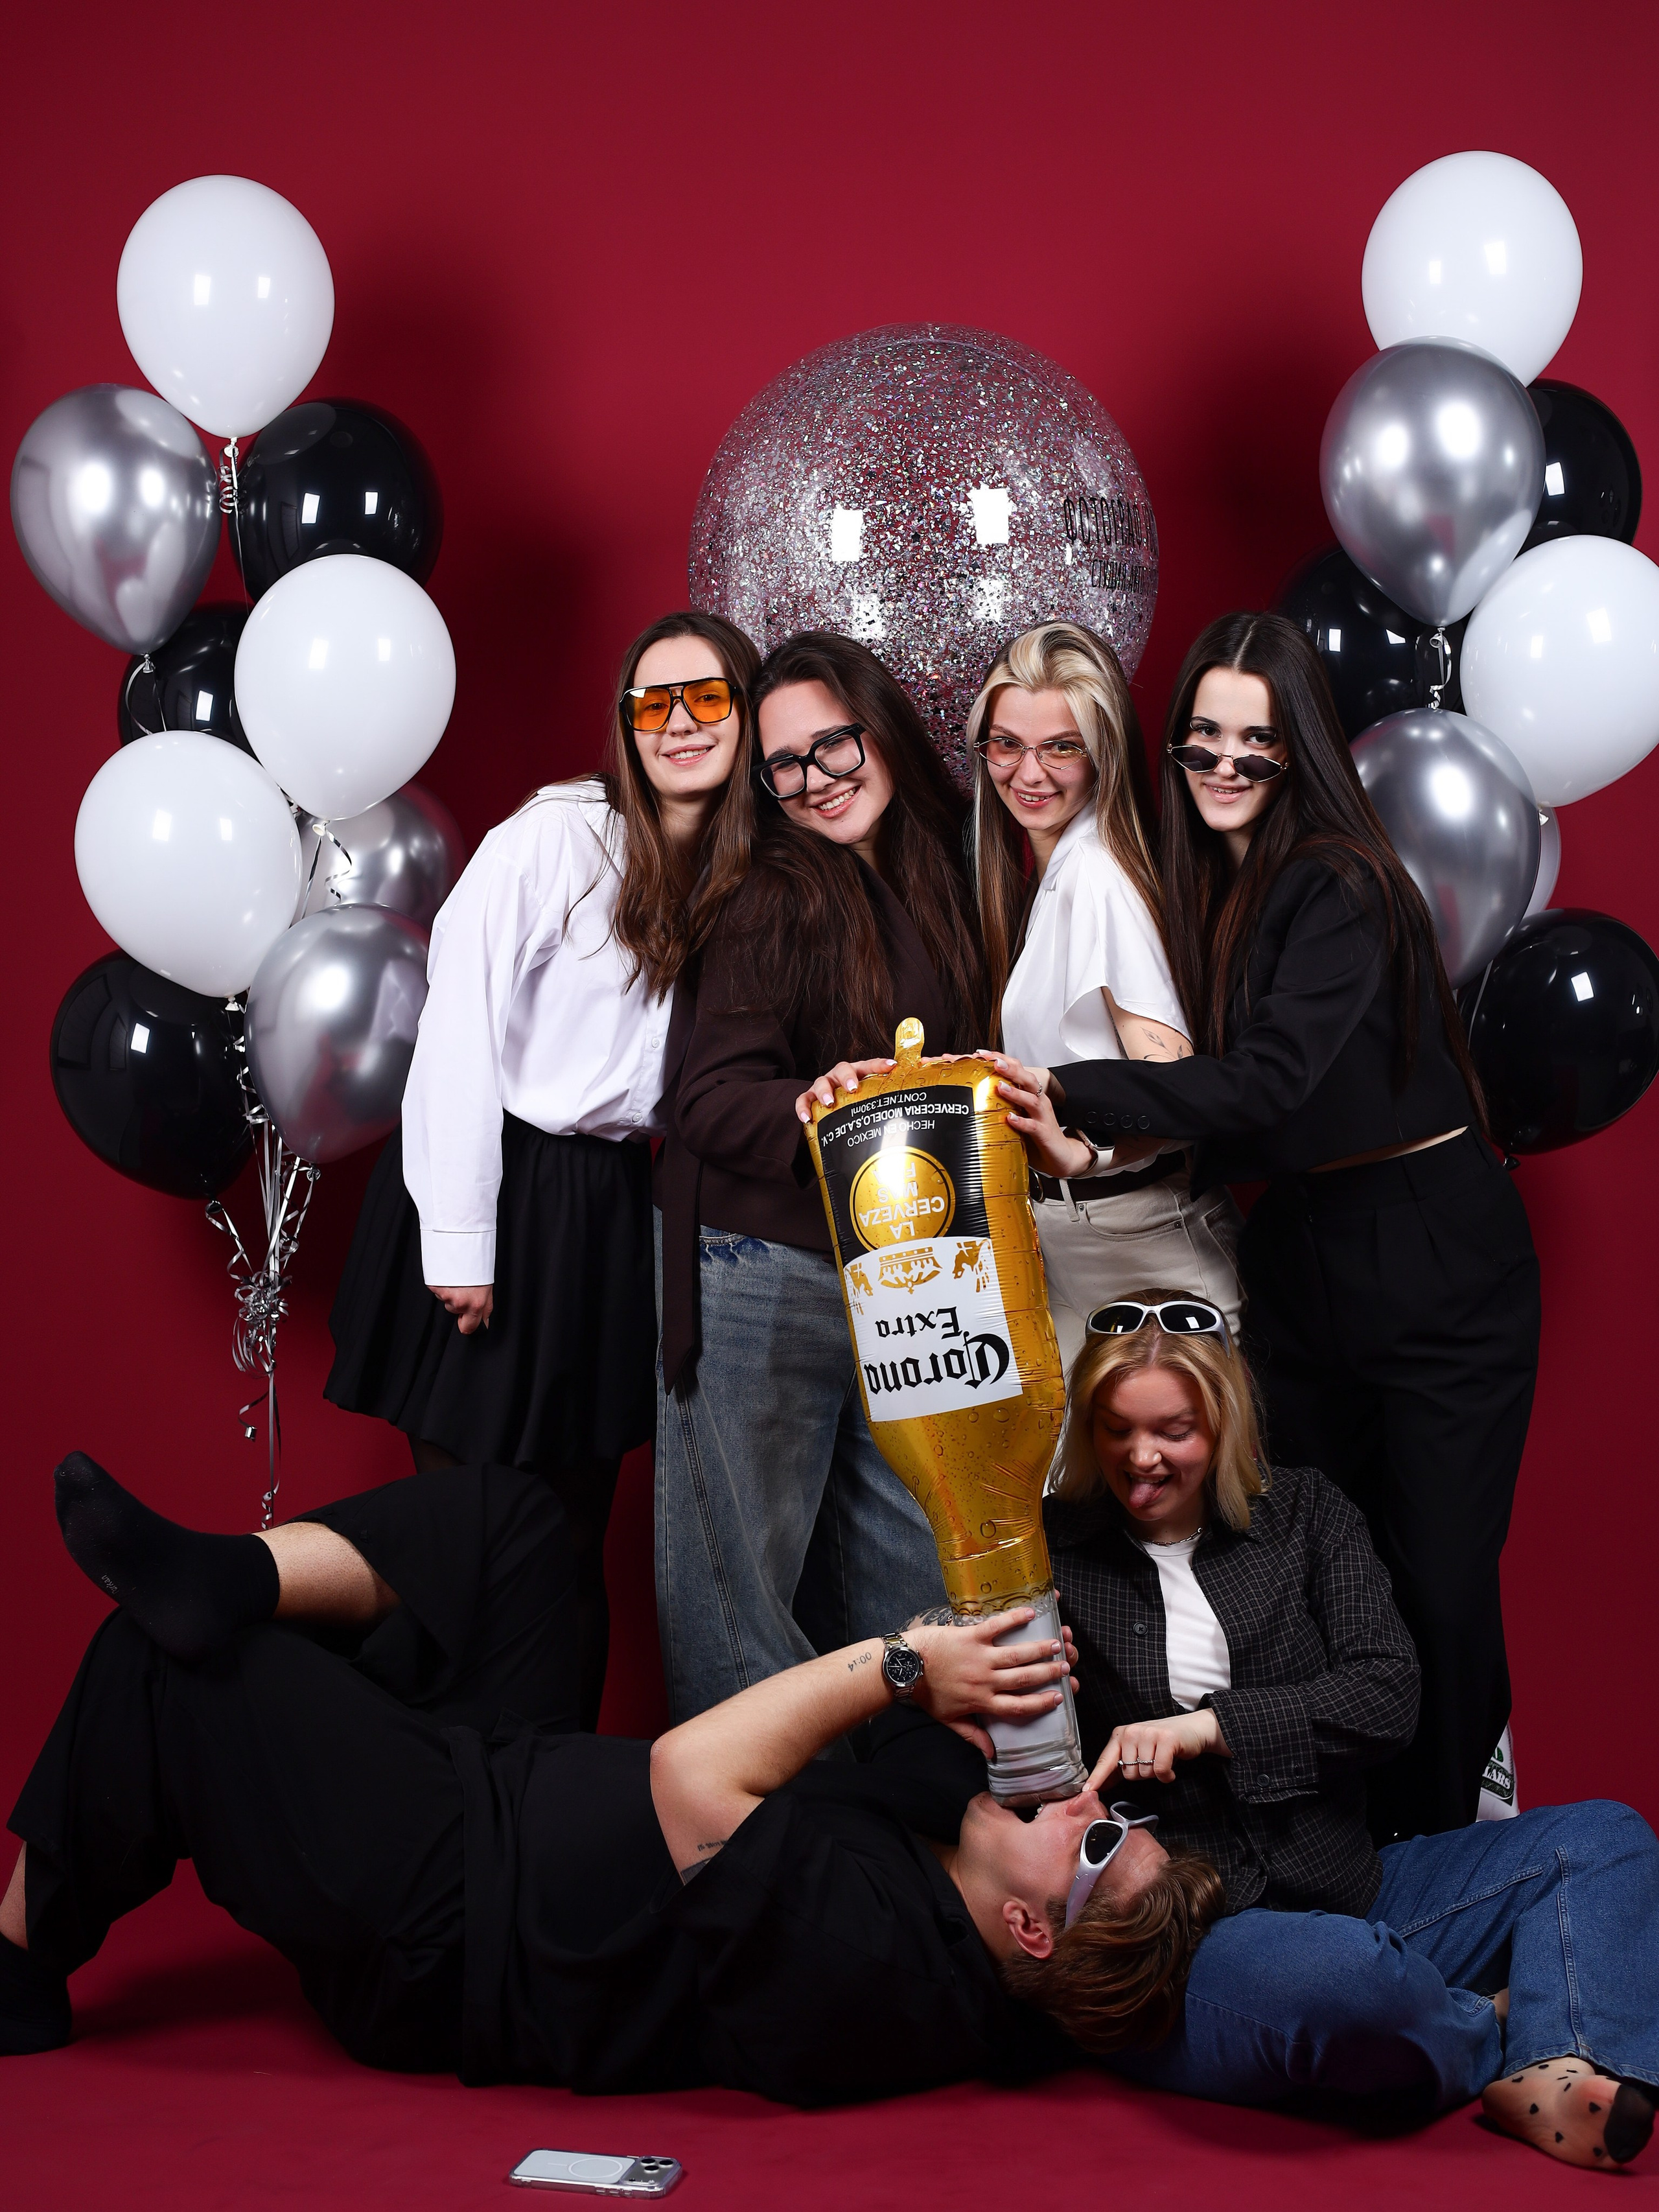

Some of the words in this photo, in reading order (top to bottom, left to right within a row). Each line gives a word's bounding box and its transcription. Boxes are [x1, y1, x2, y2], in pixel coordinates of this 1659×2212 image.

[1091, 559, 1126, 591] СТУДИЯ
[905, 1103, 969, 1116] CERVECERIA
[883, 1124, 898, 1135] EN
[899, 1120, 935, 1132] HECHO
[847, 1128, 882, 1147] MEXICO
[859, 1196, 945, 1227] CERVEZA
[889, 1221, 915, 1239] LA
[875, 1306, 962, 1340] Extra
[864, 1331, 1010, 1395] Corona
[1482, 1765, 1511, 1789] LARS
